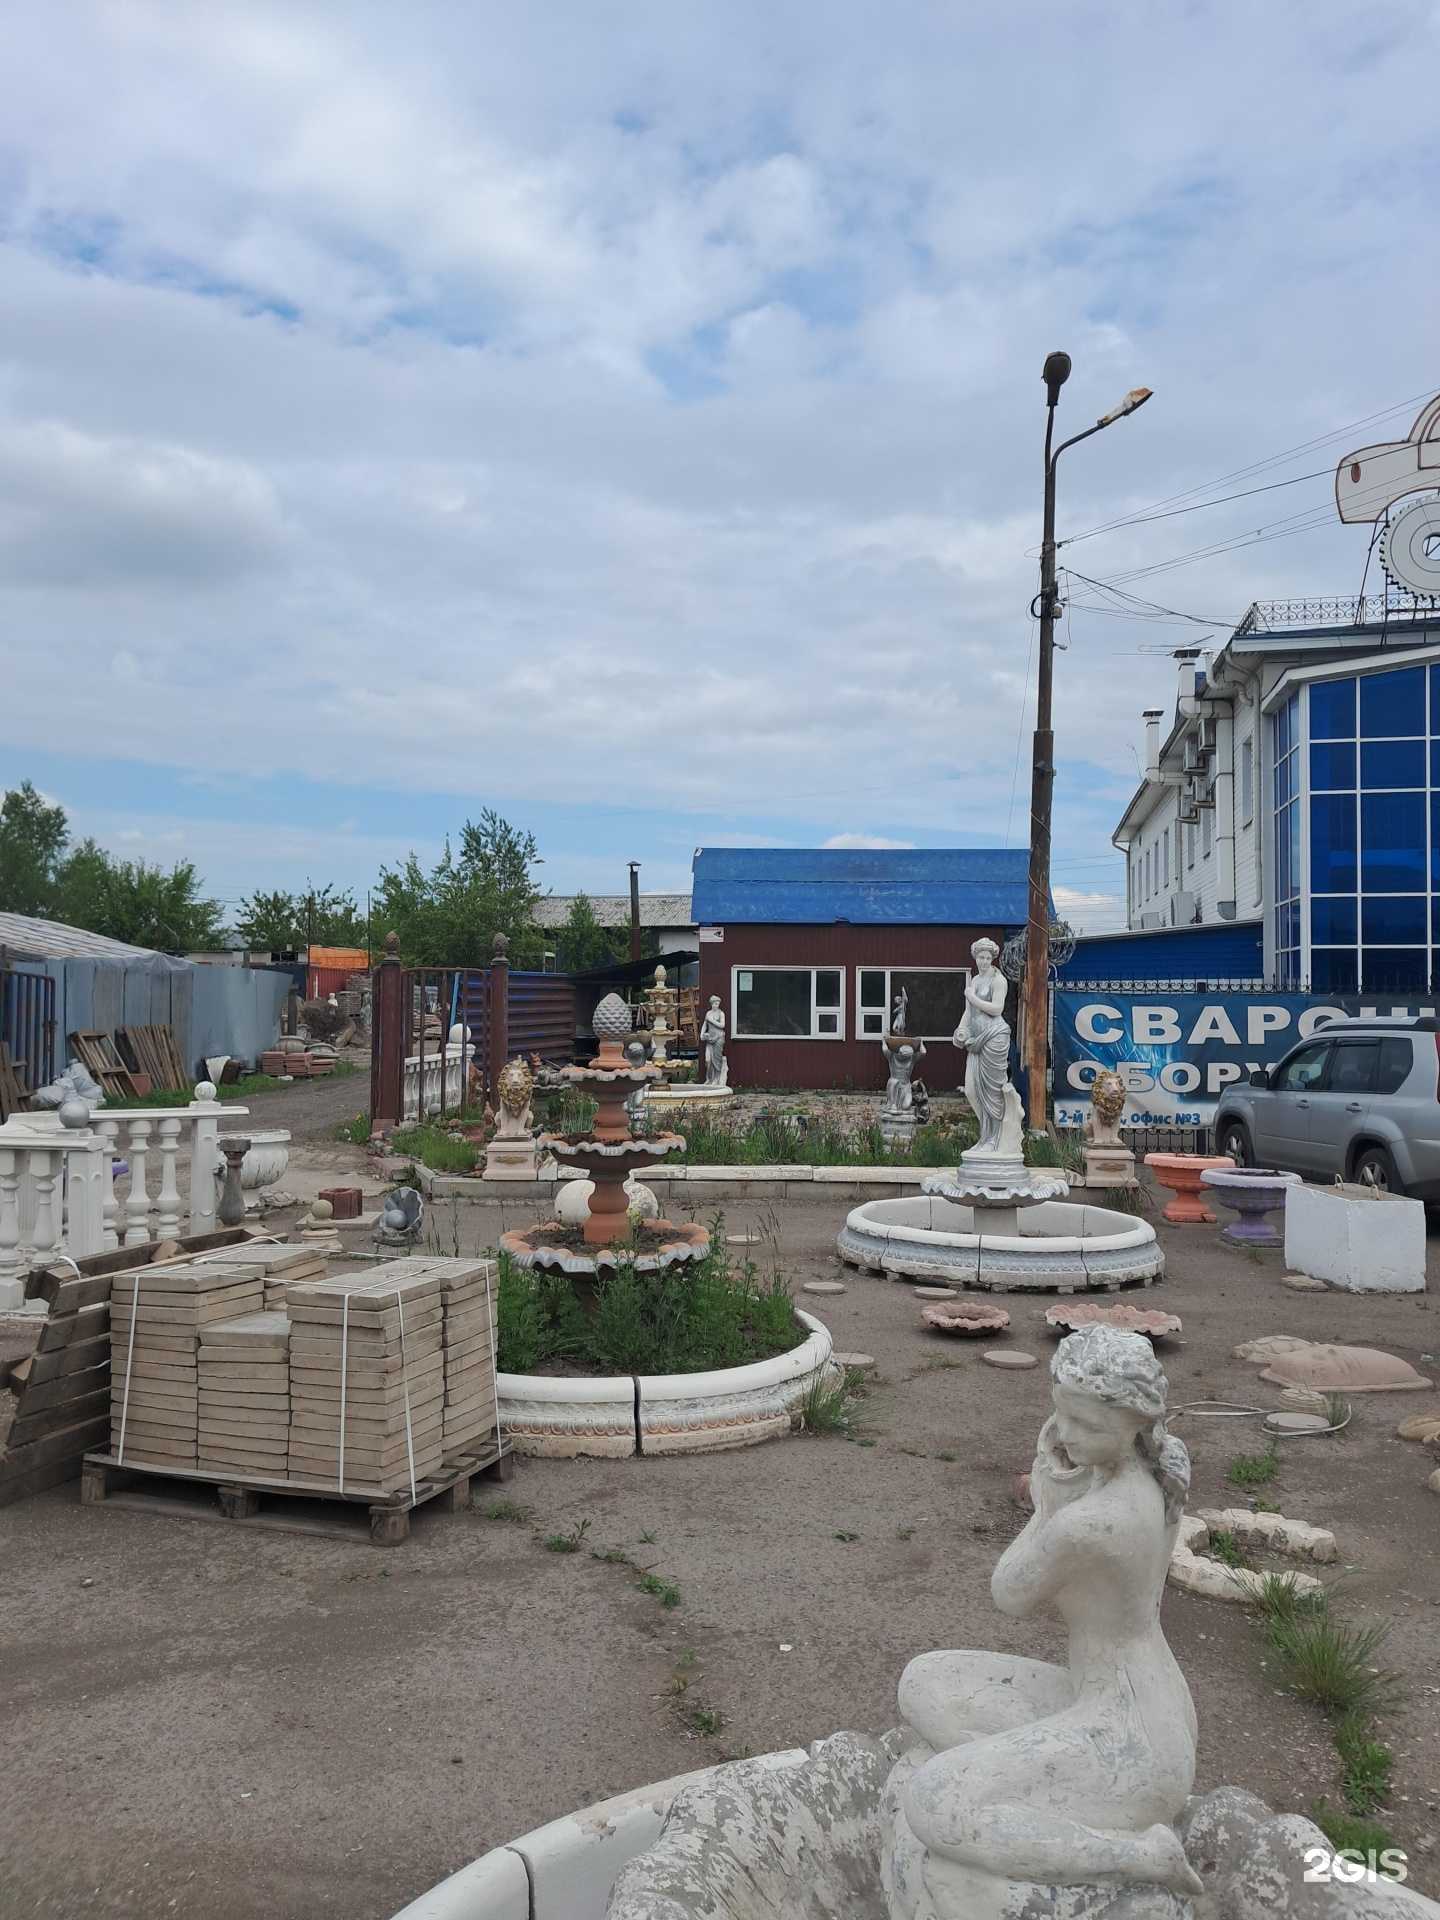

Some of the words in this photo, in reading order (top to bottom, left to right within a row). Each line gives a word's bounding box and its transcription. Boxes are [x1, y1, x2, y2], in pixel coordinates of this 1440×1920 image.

[1074, 1004, 1436, 1044] СВАРО
[1058, 1109, 1084, 1124] 2-й
[1131, 1111, 1172, 1126] офис
[1175, 1112, 1201, 1125] №3
